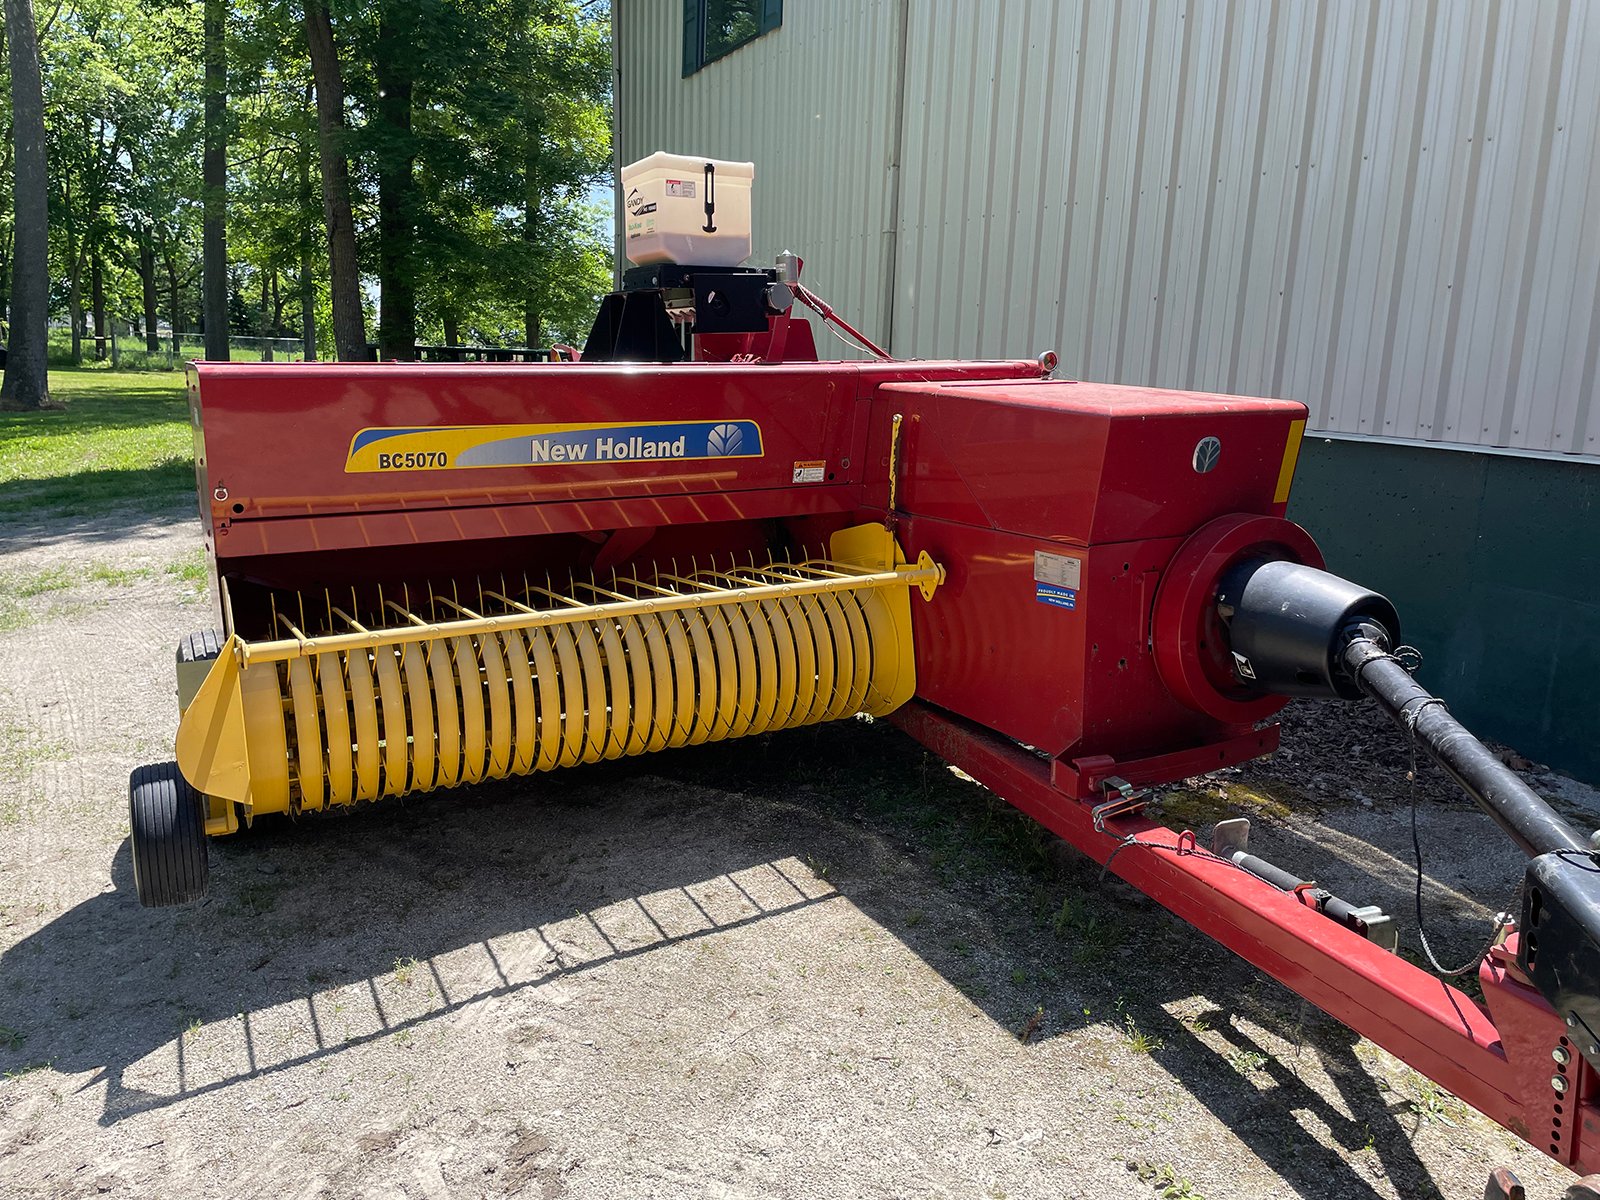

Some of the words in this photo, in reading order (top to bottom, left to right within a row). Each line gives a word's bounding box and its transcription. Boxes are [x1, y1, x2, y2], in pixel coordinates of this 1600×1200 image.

[531, 439, 588, 461] New
[596, 435, 685, 459] Holland
[379, 452, 447, 469] BC5070
